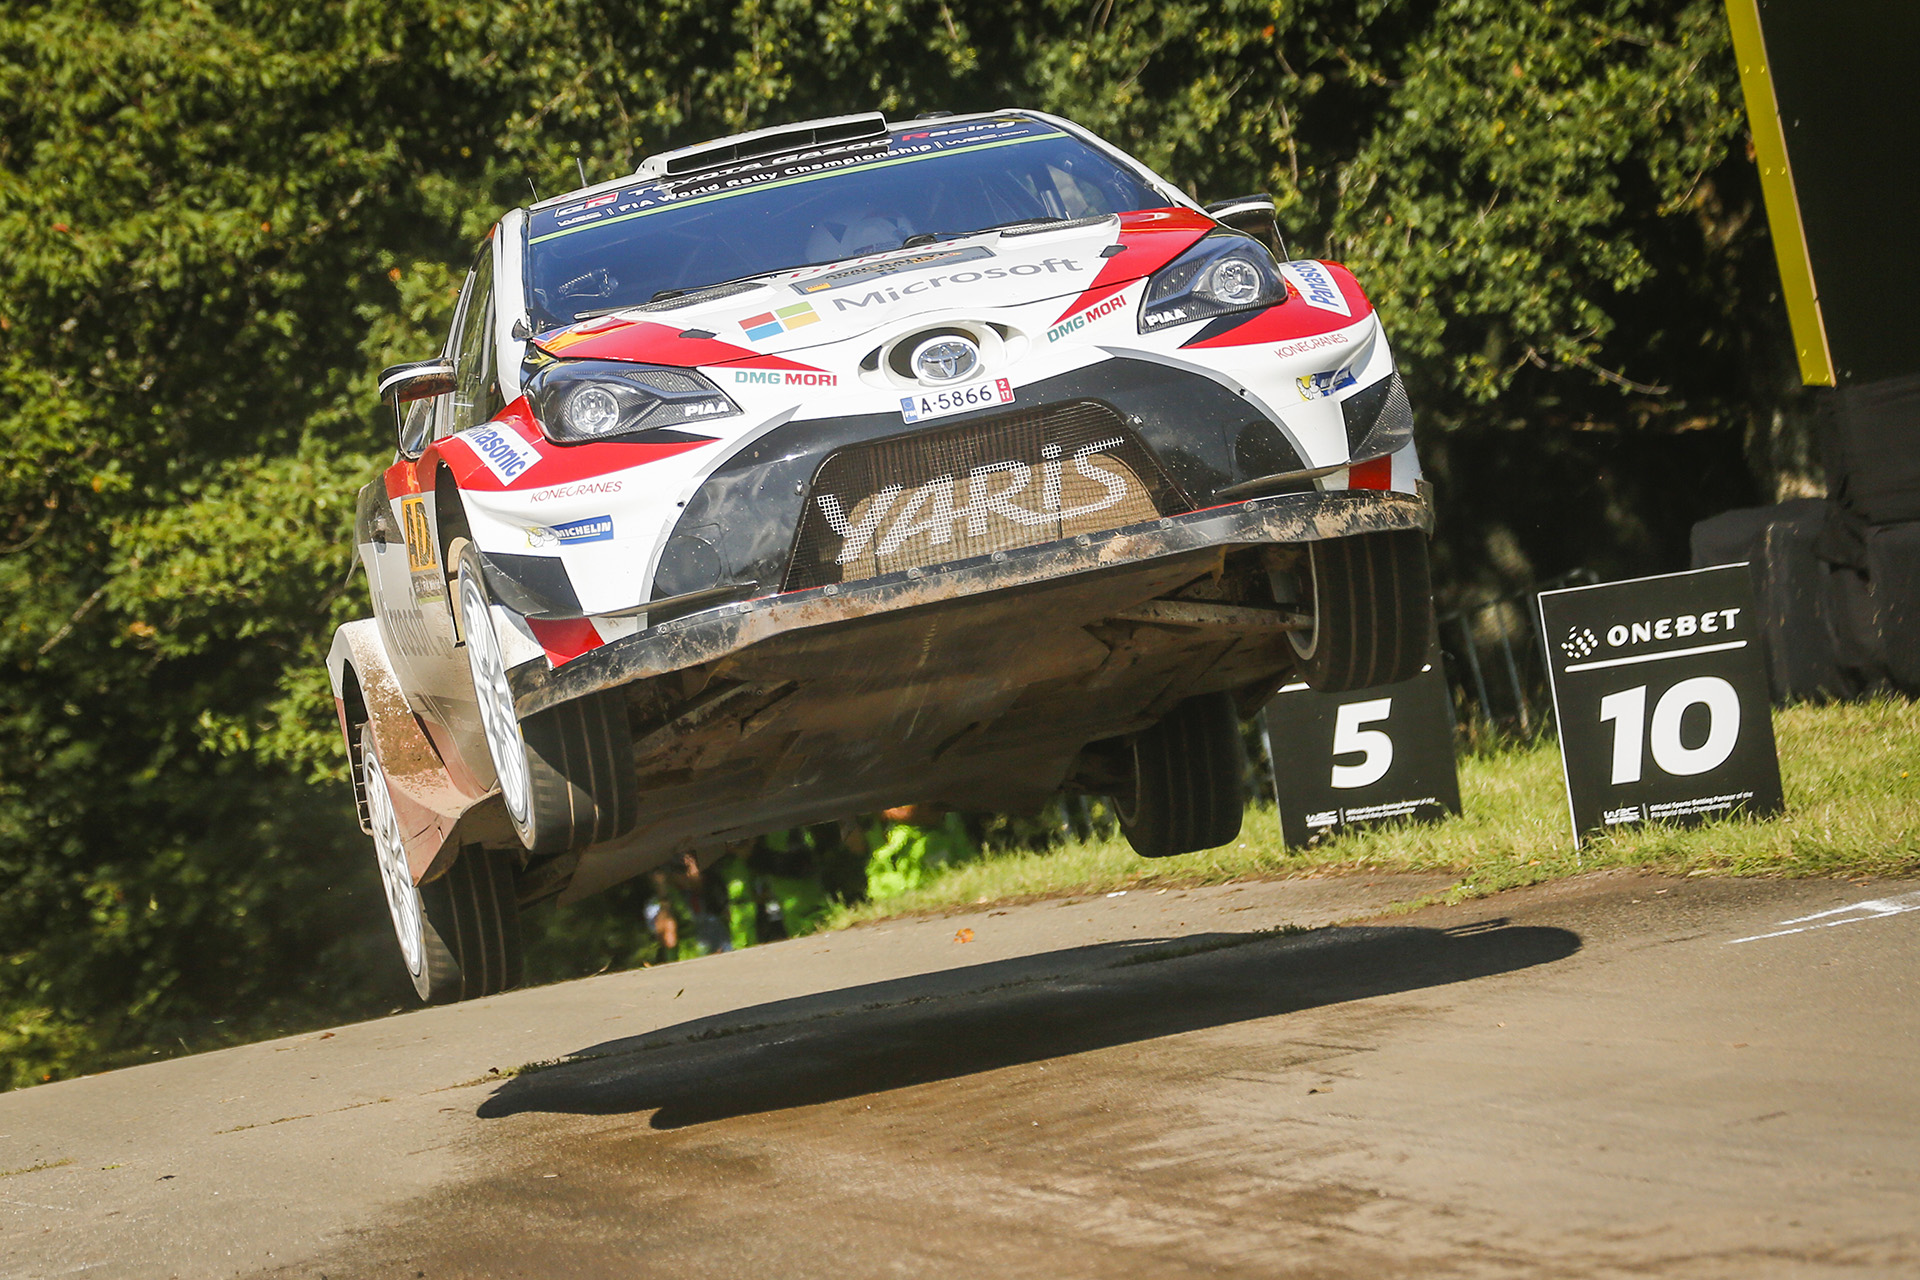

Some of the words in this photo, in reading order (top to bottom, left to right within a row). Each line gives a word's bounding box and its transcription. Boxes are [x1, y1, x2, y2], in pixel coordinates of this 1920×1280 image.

[619, 199, 655, 212] FIA
[658, 183, 720, 202] World
[726, 171, 778, 188] Rally
[784, 144, 932, 175] Championship
[628, 162, 763, 196] TOYOTA
[772, 138, 893, 166] GAZOO
[902, 121, 1016, 142] Racing
[832, 257, 1084, 312] Microsoft
[1046, 316, 1085, 344] DMG
[1085, 294, 1128, 324] MORI
[1144, 308, 1187, 327] PIAA
[1274, 333, 1349, 360] KONECRANES
[735, 371, 781, 385] DMG
[785, 373, 838, 387] MORI
[684, 401, 730, 417] PIAA
[530, 481, 623, 503] KONECRANES
[555, 521, 612, 538] MICHELIN
[1606, 607, 1741, 648] ONEBET
[1330, 697, 1394, 788] 5
[1600, 675, 1741, 786] 10
